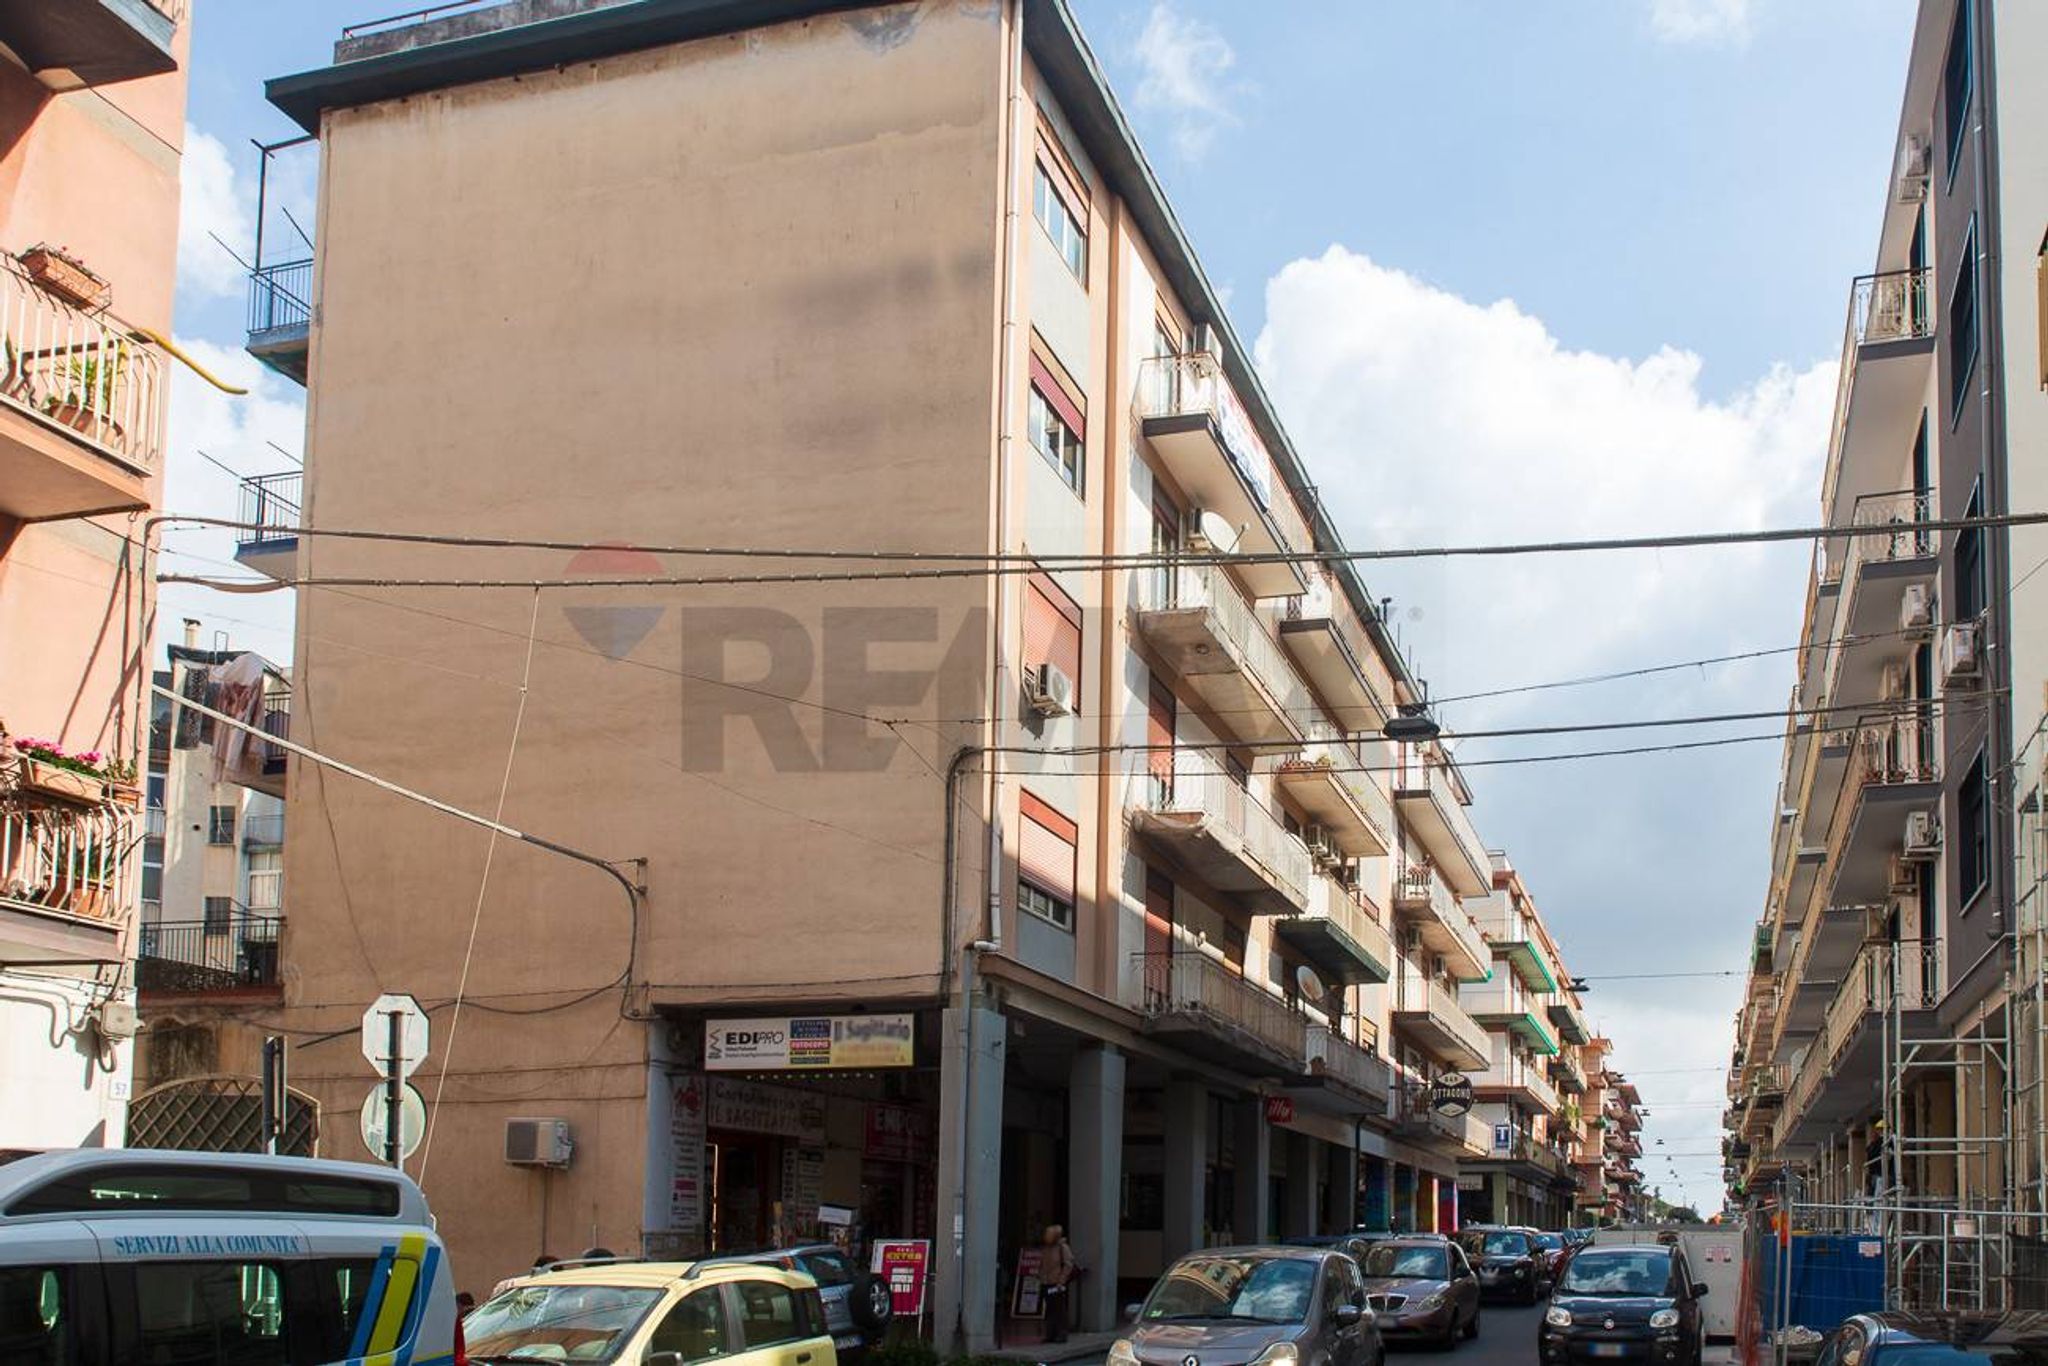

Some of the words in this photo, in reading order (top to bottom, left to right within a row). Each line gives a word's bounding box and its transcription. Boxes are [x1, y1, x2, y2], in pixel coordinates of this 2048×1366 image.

[725, 1030, 785, 1045] EDIPRO
[114, 1235, 179, 1254] SERVIZI
[185, 1235, 224, 1253] ALLA
